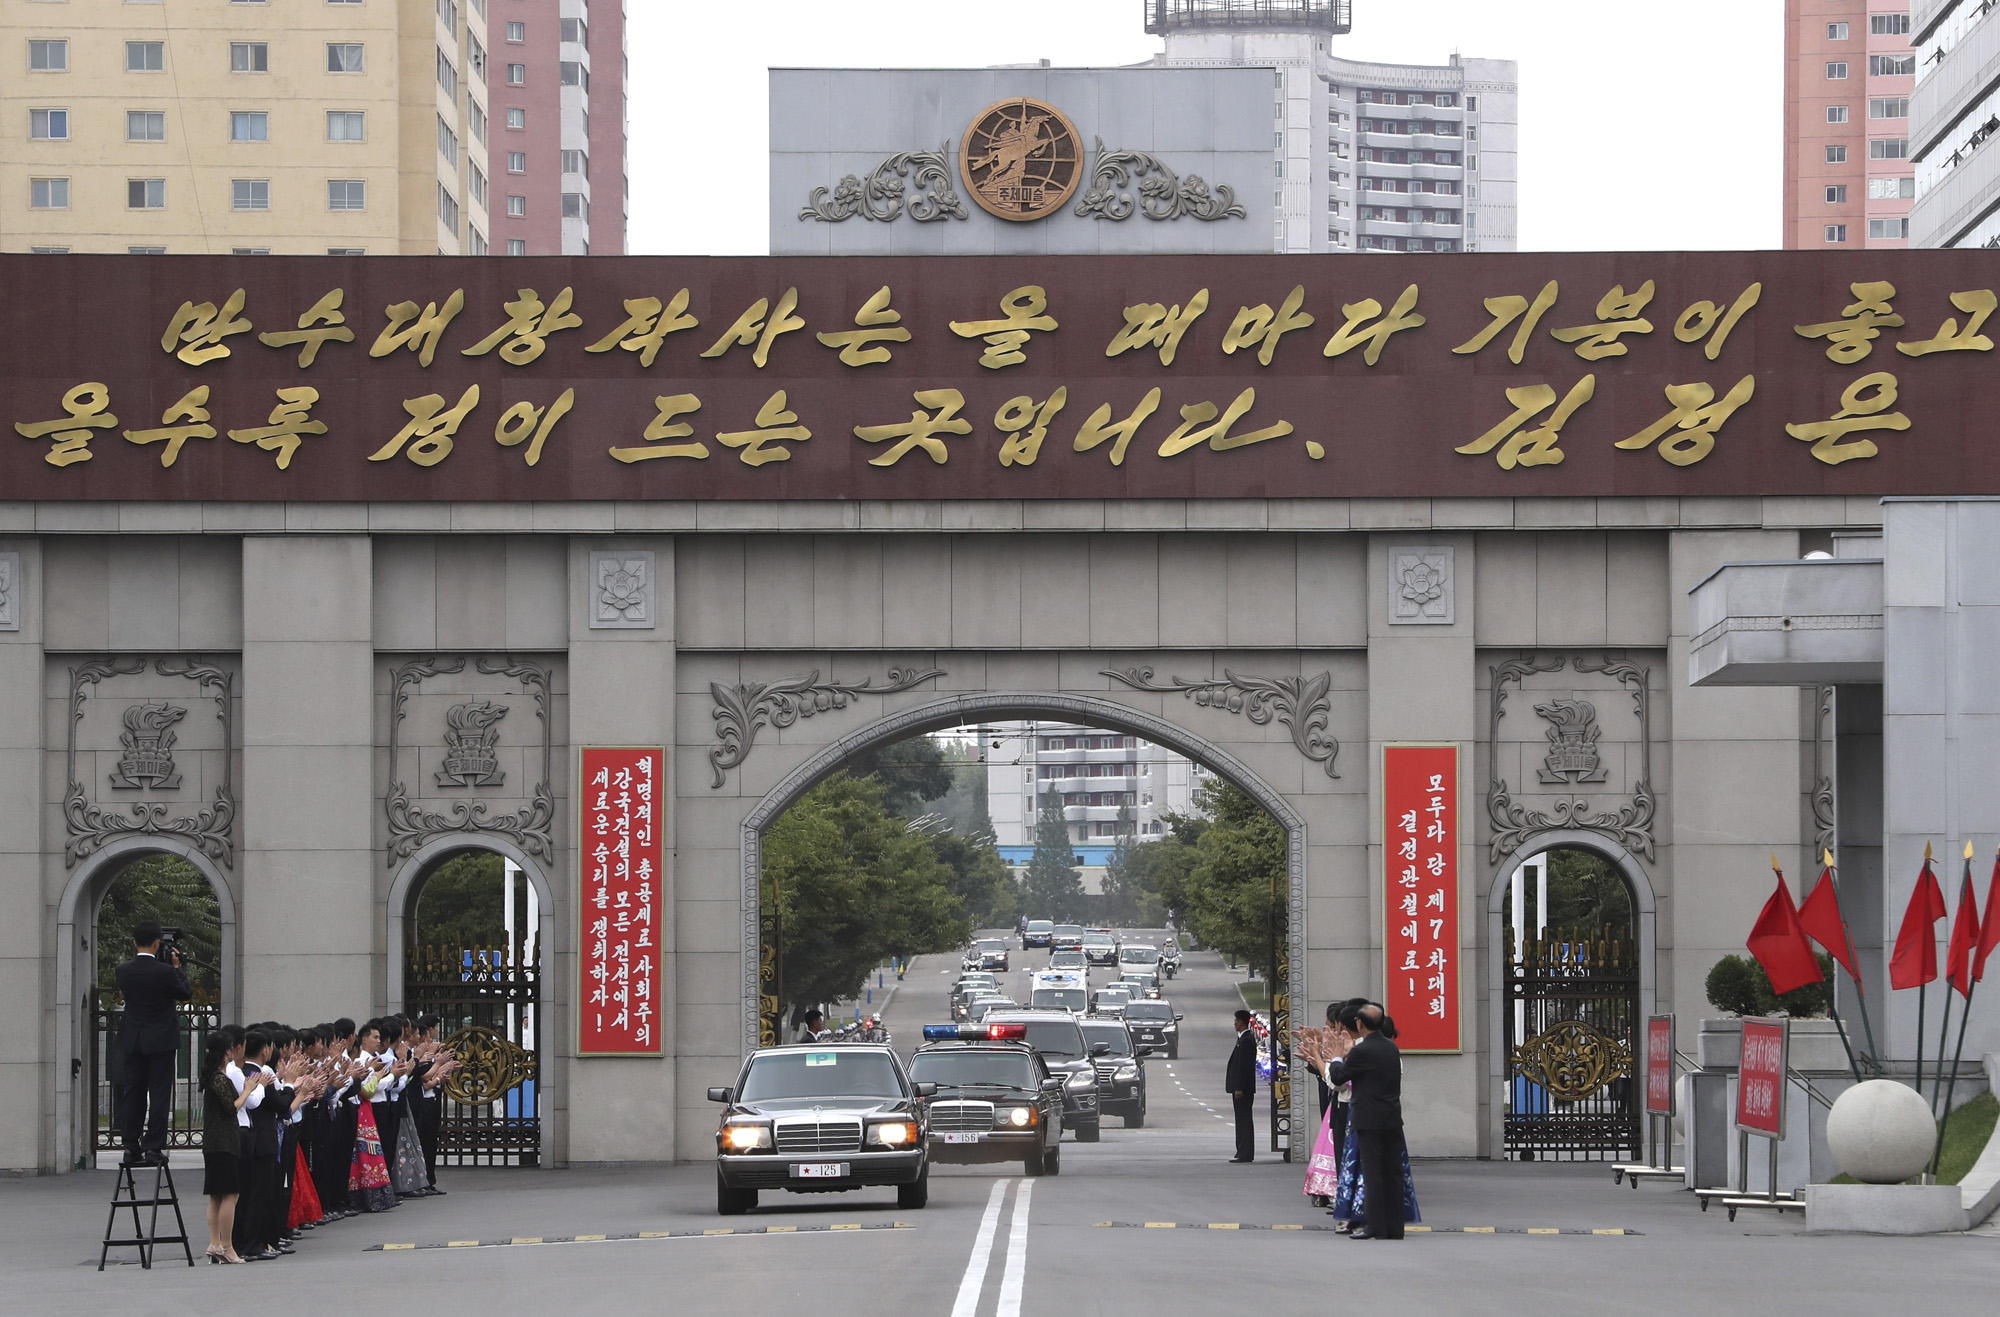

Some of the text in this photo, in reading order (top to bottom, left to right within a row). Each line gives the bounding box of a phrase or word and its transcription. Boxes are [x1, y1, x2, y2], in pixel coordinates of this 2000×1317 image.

[999, 187, 1043, 201] 주체미술
[1452, 279, 1762, 365] 기분이
[1793, 280, 1998, 364] 좋고
[15, 381, 328, 469] 올수록
[608, 389, 812, 467] 드는
[1455, 371, 1912, 470] 김정은
[123, 761, 169, 775] 주체미술
[448, 759, 493, 773] 주체미술
[590, 766, 611, 836] 새로운
[590, 841, 610, 909] 승리를
[610, 766, 634, 1032] 강국건설의 모든 전선에서
[632, 755, 654, 1047] 혁명적인 총공세로 사회주의
